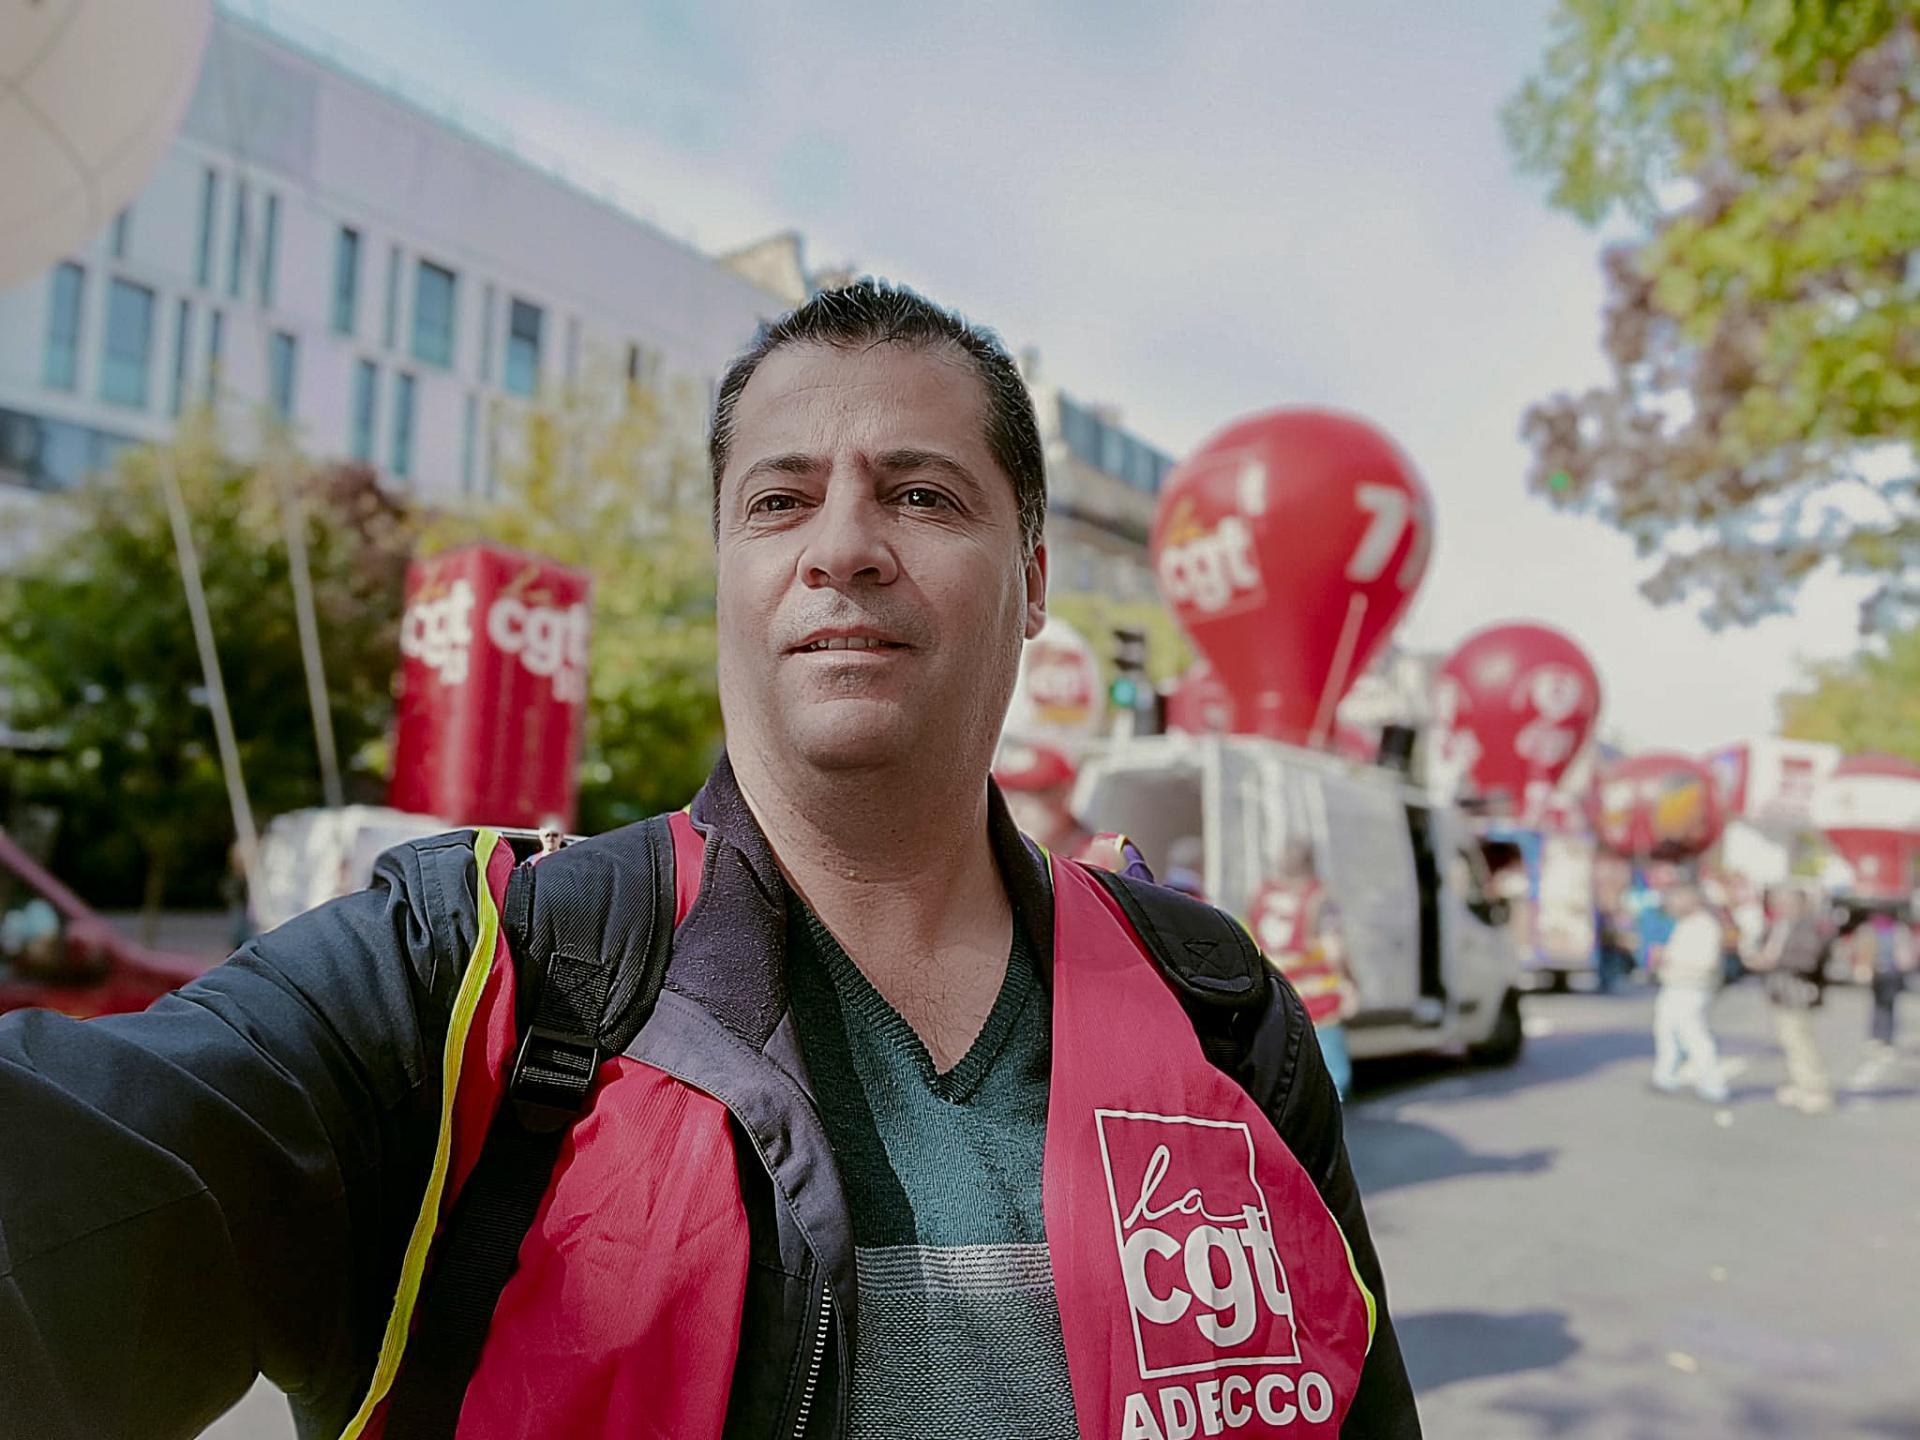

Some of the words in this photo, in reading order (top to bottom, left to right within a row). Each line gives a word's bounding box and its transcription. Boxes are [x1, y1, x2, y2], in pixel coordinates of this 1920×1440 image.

[1122, 1143, 1248, 1230] la
[1120, 1204, 1292, 1348] cgt
[1121, 1371, 1334, 1440] ADECCO
